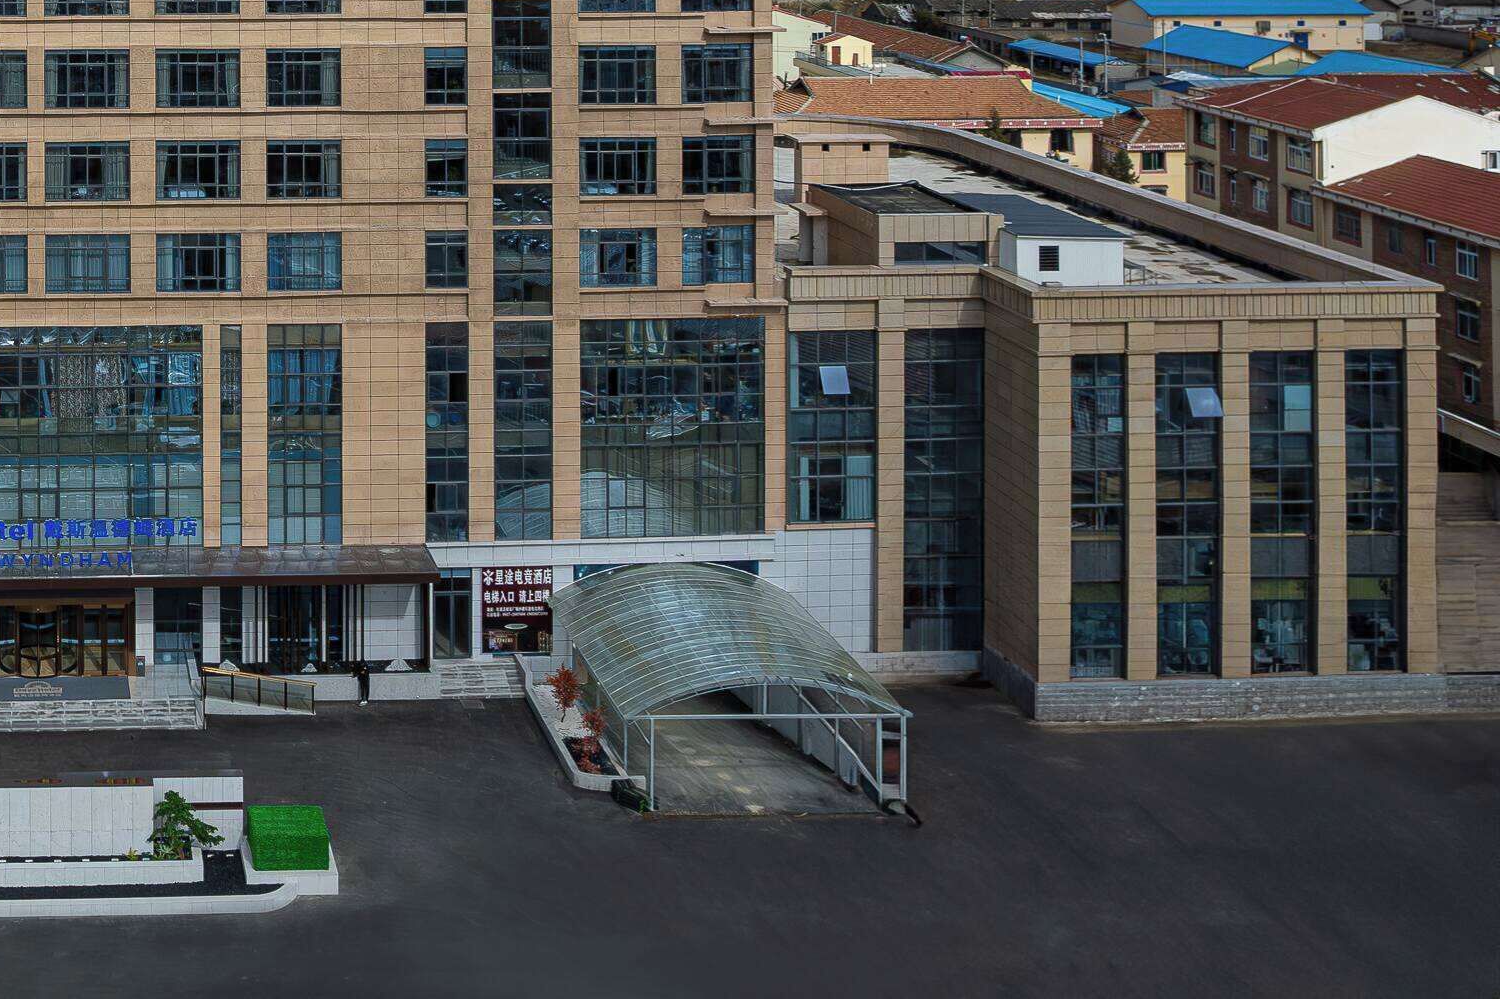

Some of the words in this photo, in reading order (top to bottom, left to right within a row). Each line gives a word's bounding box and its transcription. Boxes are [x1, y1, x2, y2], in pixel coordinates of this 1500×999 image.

[495, 568, 552, 585] 星途电竞酒店
[484, 590, 515, 603] 电梯入口
[519, 589, 550, 603] 请上四楼
